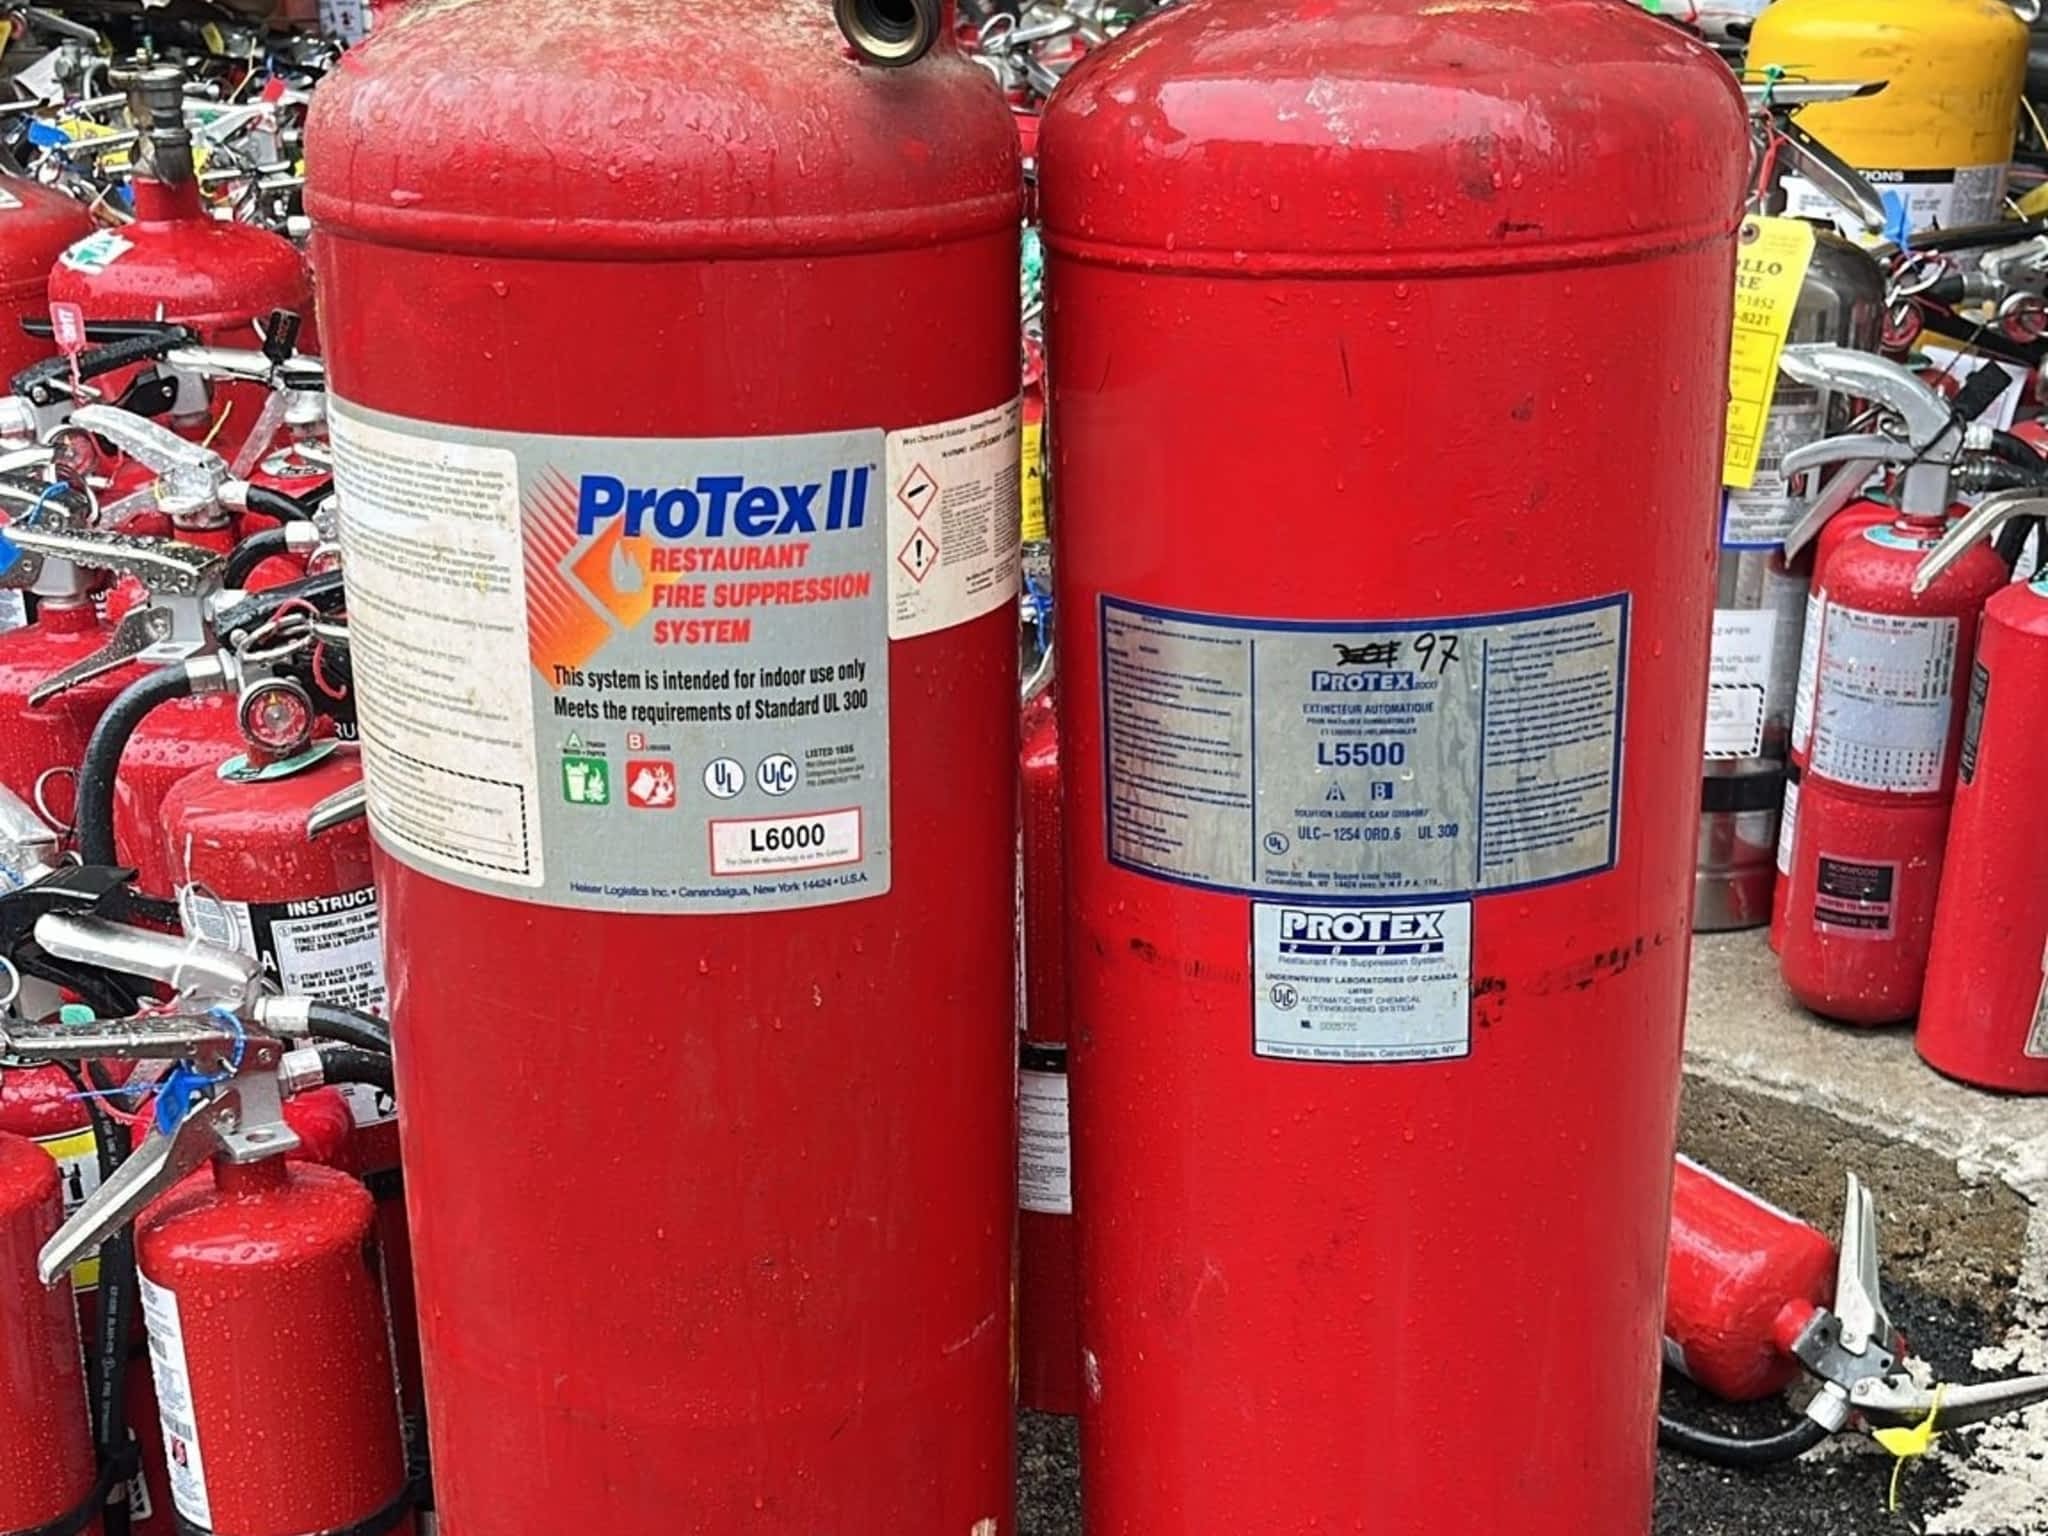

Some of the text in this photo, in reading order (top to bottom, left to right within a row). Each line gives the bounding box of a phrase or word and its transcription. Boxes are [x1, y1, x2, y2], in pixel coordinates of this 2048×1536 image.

[577, 475, 822, 539] ProTex
[651, 543, 810, 572] RESTAURANT
[652, 584, 705, 608] FIRE
[712, 573, 871, 608] SUPPRESSION
[654, 619, 751, 644] SYSTEM
[1414, 633, 1459, 674] 97
[554, 658, 866, 692] This system is intended for indoor use only
[1315, 672, 1411, 691] PROTEX
[554, 688, 868, 726] Meets the requirements of Standard UL 300
[1303, 702, 1434, 715] EXTINCTEUR AUTOMATIQUE
[1318, 742, 1405, 765] L5500
[750, 823, 825, 851] L6000
[1418, 826, 1432, 839] UL
[1437, 823, 1459, 838] 300
[287, 888, 374, 917] INSTRUCT
[570, 882, 602, 894] Heiser
[604, 883, 649, 898] Logistics
[651, 887, 670, 897] Inc.
[754, 884, 776, 895] New
[778, 881, 799, 893] York
[1280, 909, 1445, 941] PROTEX
[1278, 955, 1328, 965] Restaurant
[1330, 957, 1348, 966] Fire
[1350, 957, 1409, 968] Suppression
